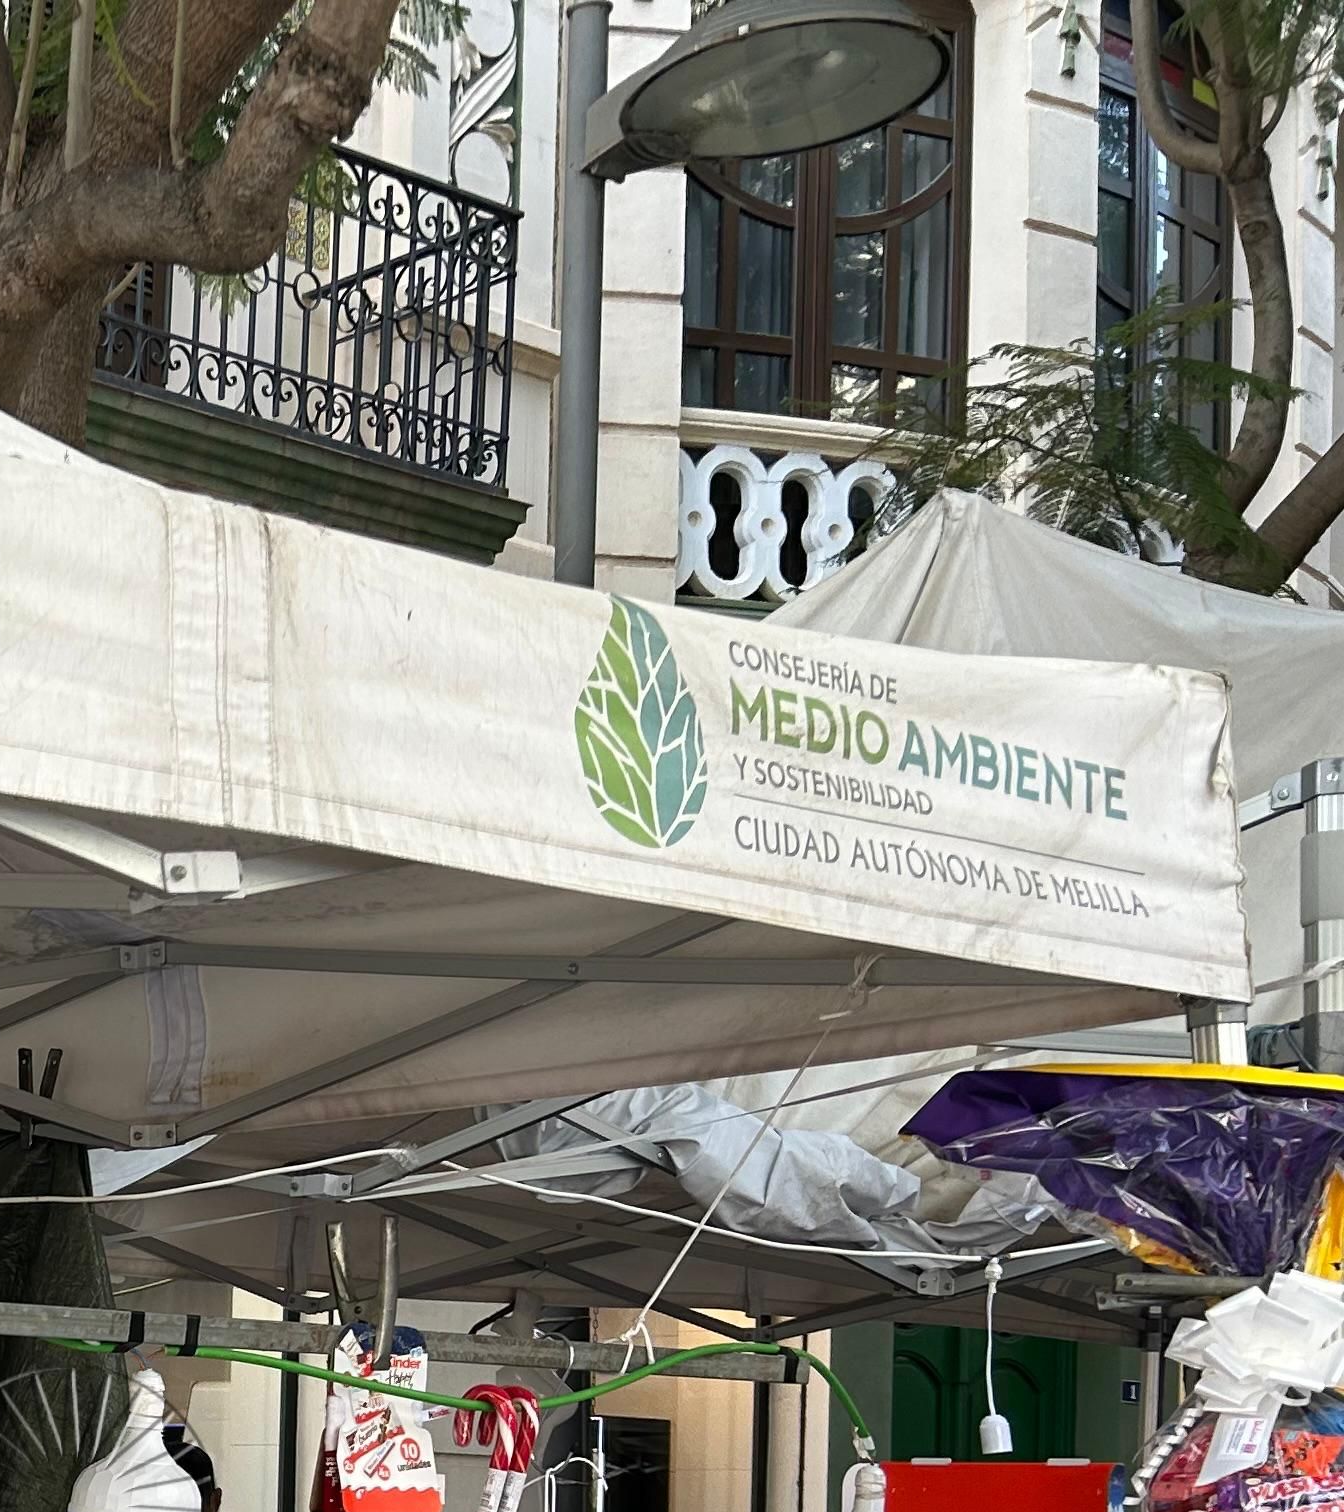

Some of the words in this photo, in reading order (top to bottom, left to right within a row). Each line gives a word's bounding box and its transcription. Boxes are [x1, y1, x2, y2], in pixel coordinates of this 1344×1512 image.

[729, 640, 865, 698] CONSEJERÍA
[869, 673, 899, 705] DE
[729, 678, 891, 766] MEDIO
[898, 719, 1129, 822] AMBIENTE
[733, 753, 749, 782] Y
[754, 758, 934, 817] SOSTENIBILIDAD
[734, 815, 841, 865] CIUDAD
[850, 837, 1012, 895] AUTÓNOMA
[1013, 866, 1049, 902] DE
[1050, 873, 1151, 919] MELILLA
[390, 1355, 422, 1369] inder
[402, 1443, 418, 1459] 10
